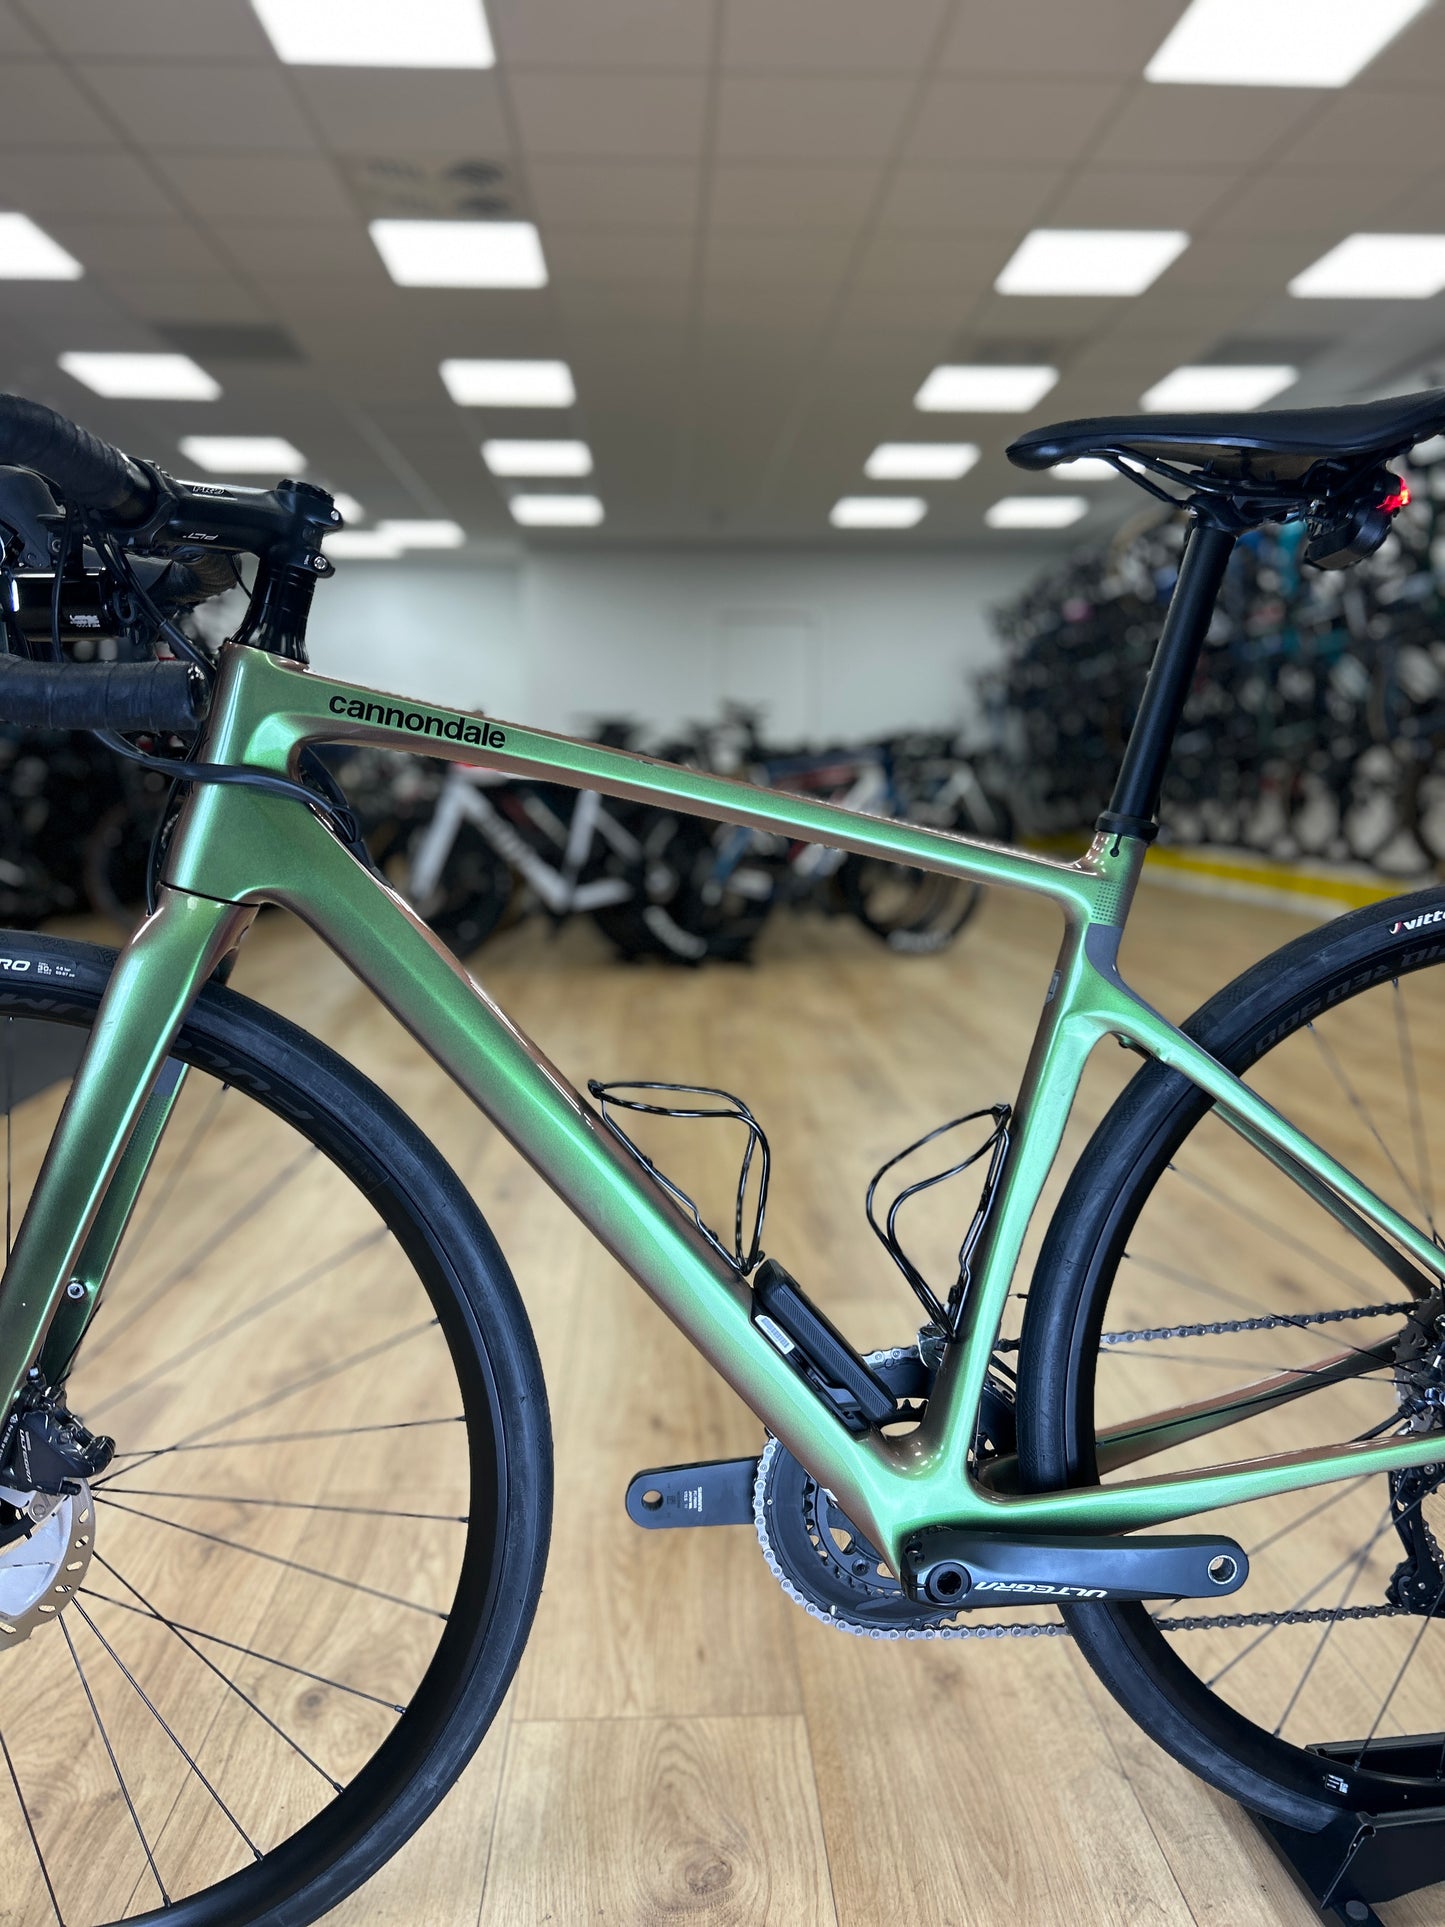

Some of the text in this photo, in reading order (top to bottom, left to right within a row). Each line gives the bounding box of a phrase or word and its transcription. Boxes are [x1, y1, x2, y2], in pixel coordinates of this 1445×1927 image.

[329, 695, 506, 749] cannondale
[1403, 910, 1445, 930] vitt
[974, 1581, 1108, 1598] ULTEGRA
